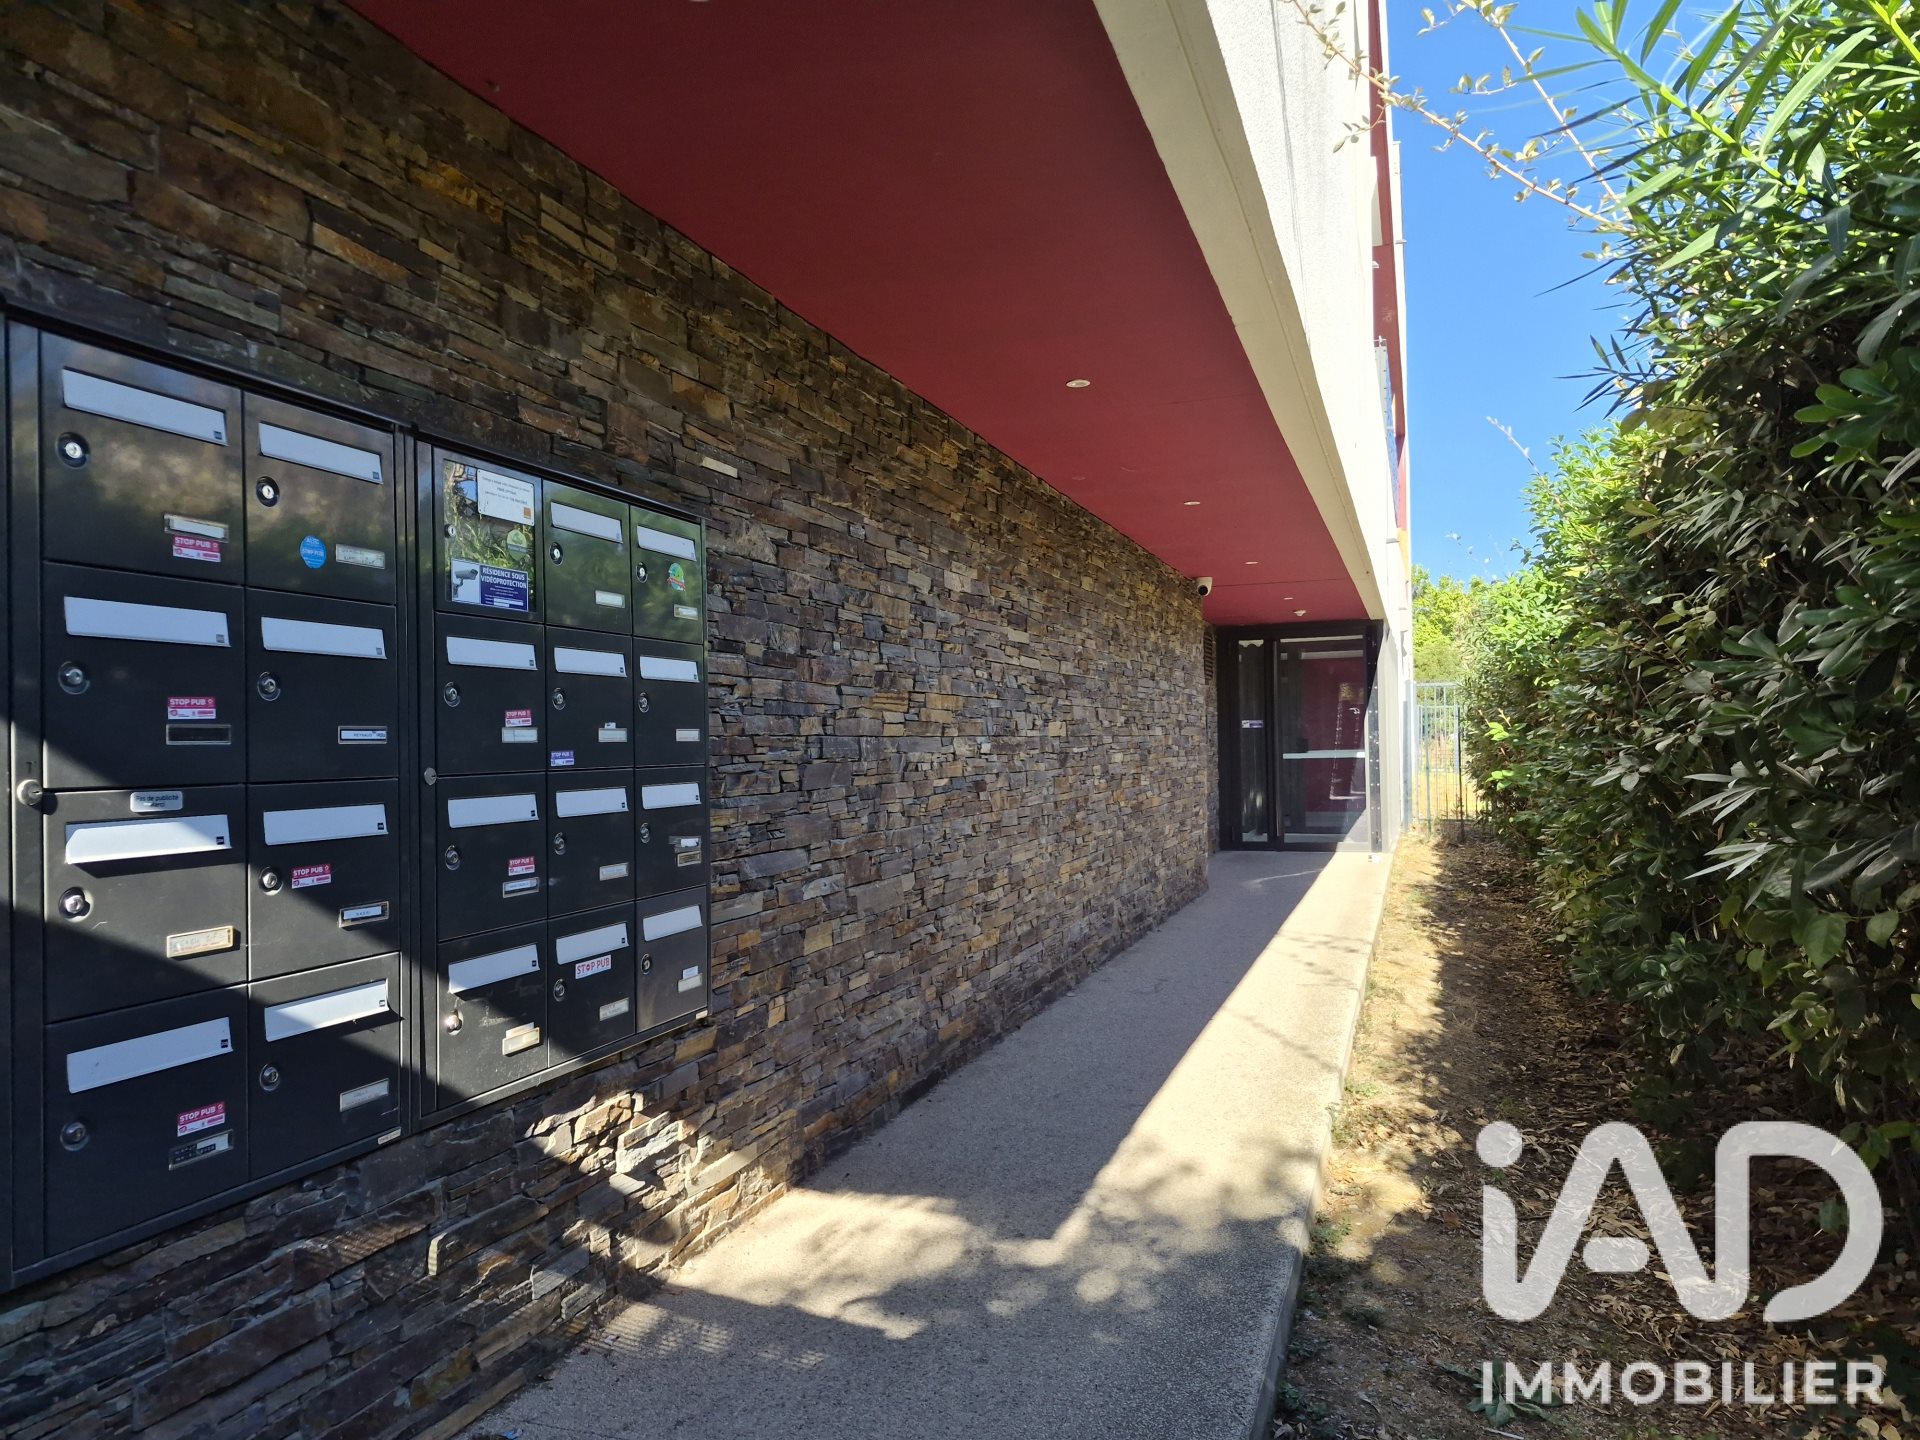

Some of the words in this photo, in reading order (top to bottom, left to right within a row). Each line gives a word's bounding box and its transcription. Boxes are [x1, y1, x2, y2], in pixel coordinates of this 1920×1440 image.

[174, 536, 195, 546] STOP
[195, 539, 212, 548] PUB
[482, 566, 511, 578] RÉSIDENCE
[511, 572, 525, 580] SOUS
[480, 575, 527, 589] VIDÉOPROTECTION
[169, 698, 190, 706] STOP
[190, 698, 206, 706] PUB
[293, 868, 310, 877] STOP
[310, 866, 324, 874] PUB
[576, 962, 596, 975] STOP
[596, 956, 610, 969] PUB
[179, 1110, 200, 1122] STOP
[200, 1106, 216, 1116] PUB
